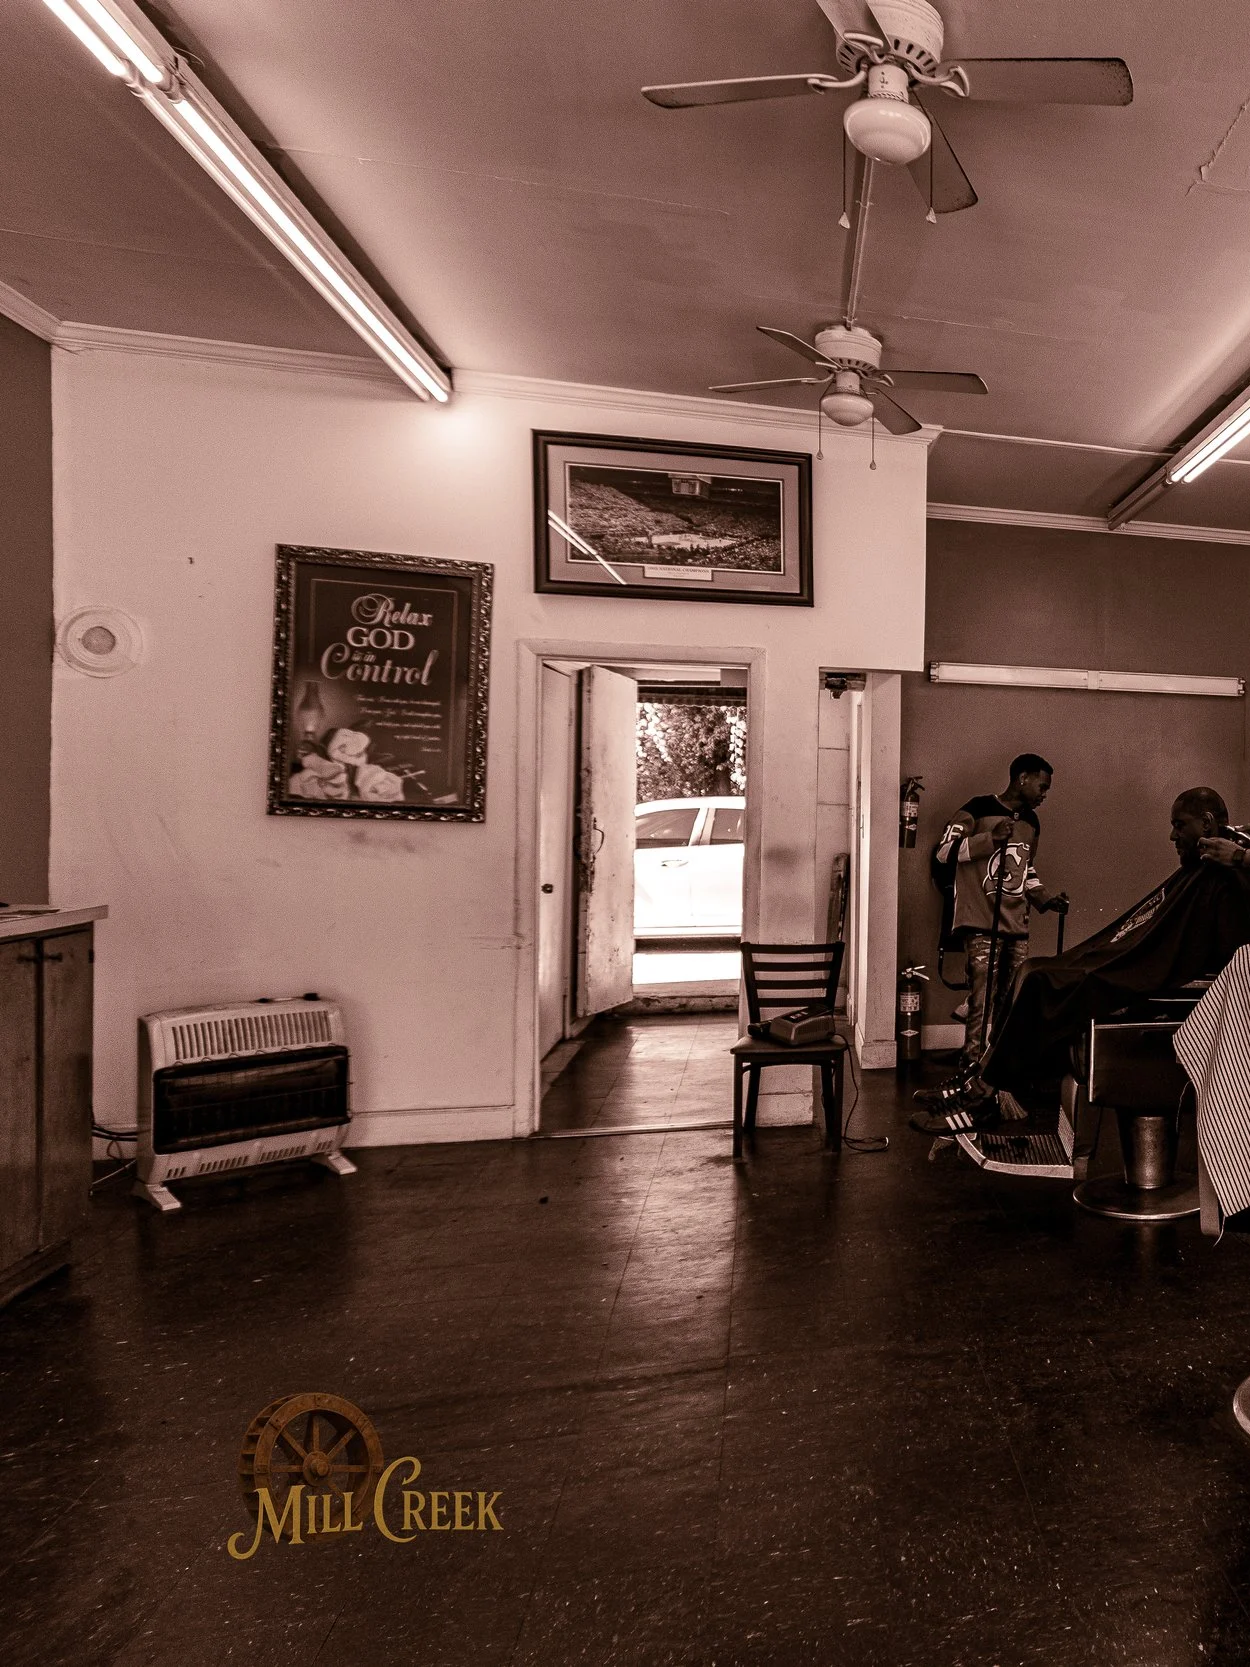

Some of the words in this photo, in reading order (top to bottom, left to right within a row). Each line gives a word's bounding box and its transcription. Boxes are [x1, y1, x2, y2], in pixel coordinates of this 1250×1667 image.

[351, 593, 434, 627] Relax
[346, 626, 415, 650] GOD
[320, 642, 439, 686] Control
